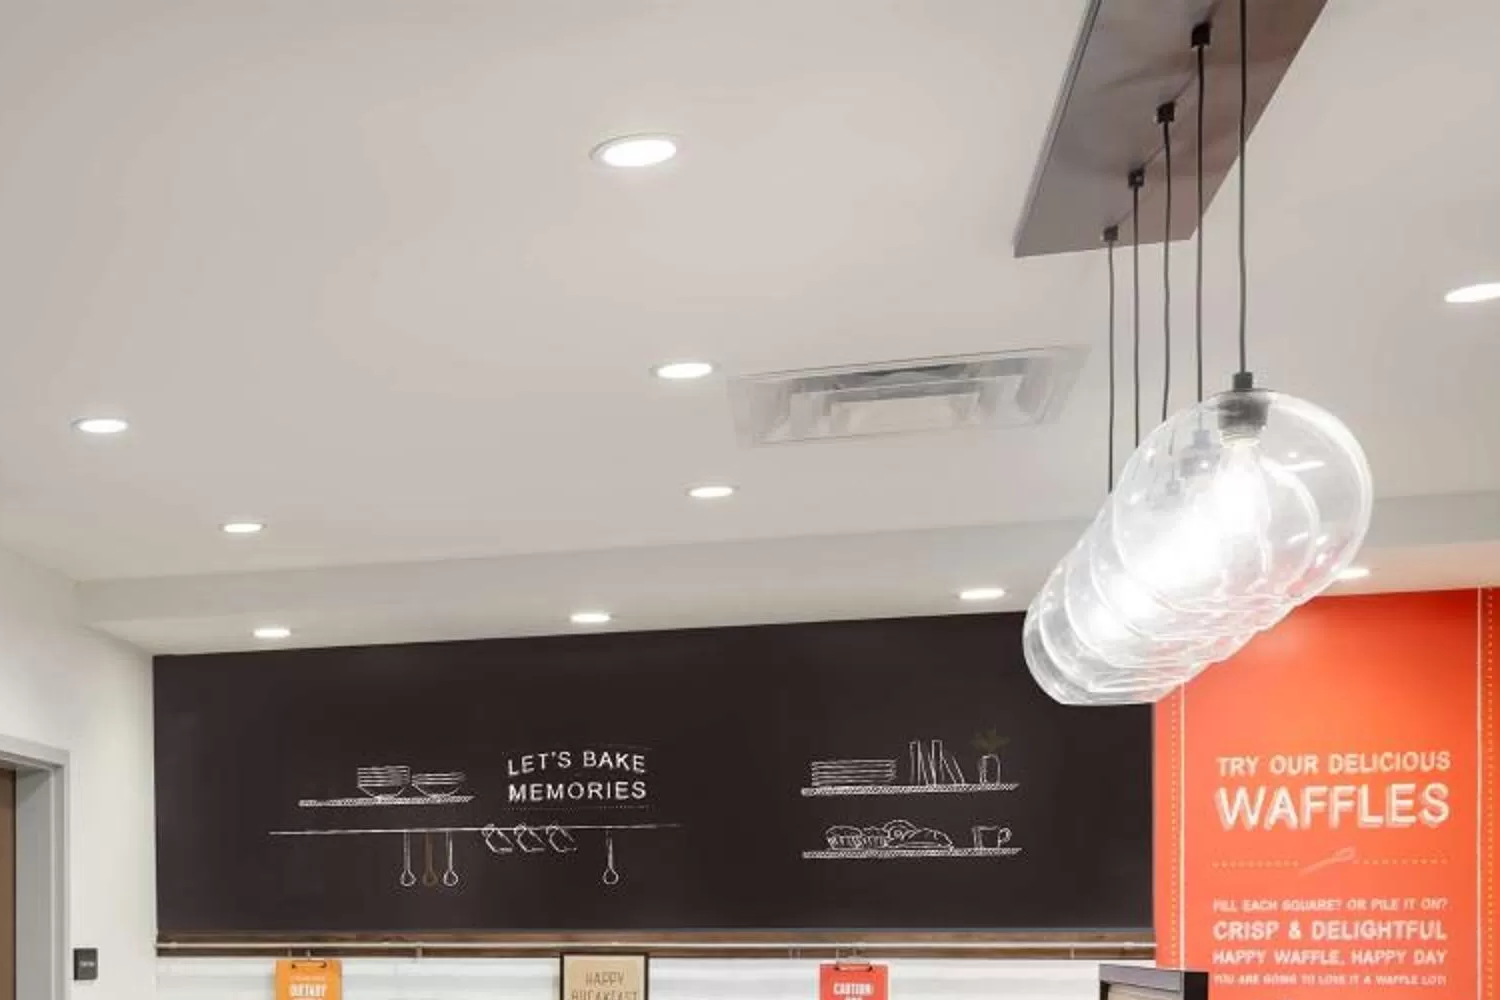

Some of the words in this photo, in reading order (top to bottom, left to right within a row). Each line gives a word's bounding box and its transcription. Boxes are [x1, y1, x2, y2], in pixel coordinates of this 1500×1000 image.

[507, 751, 572, 776] LET'S
[583, 750, 646, 773] BAKE
[1216, 756, 1259, 777] TRY
[1269, 754, 1319, 775] OUR
[1328, 751, 1450, 775] DELICIOUS
[508, 781, 647, 802] MEMORIES
[1215, 783, 1450, 831] WAFFLES
[1212, 898, 1238, 912] FILL
[1243, 898, 1277, 912] EACH
[1346, 898, 1366, 911] OR
[1371, 898, 1398, 911] PILE
[1403, 898, 1415, 911] IT
[1420, 897, 1448, 911] ON?
[1212, 920, 1279, 941] CRISP
[1288, 920, 1302, 940] &
[1311, 919, 1448, 941] DELIGHTFUL
[1212, 949, 1266, 965] HAPPY
[1352, 949, 1406, 964] HAPPY
[1413, 949, 1448, 964] DAY
